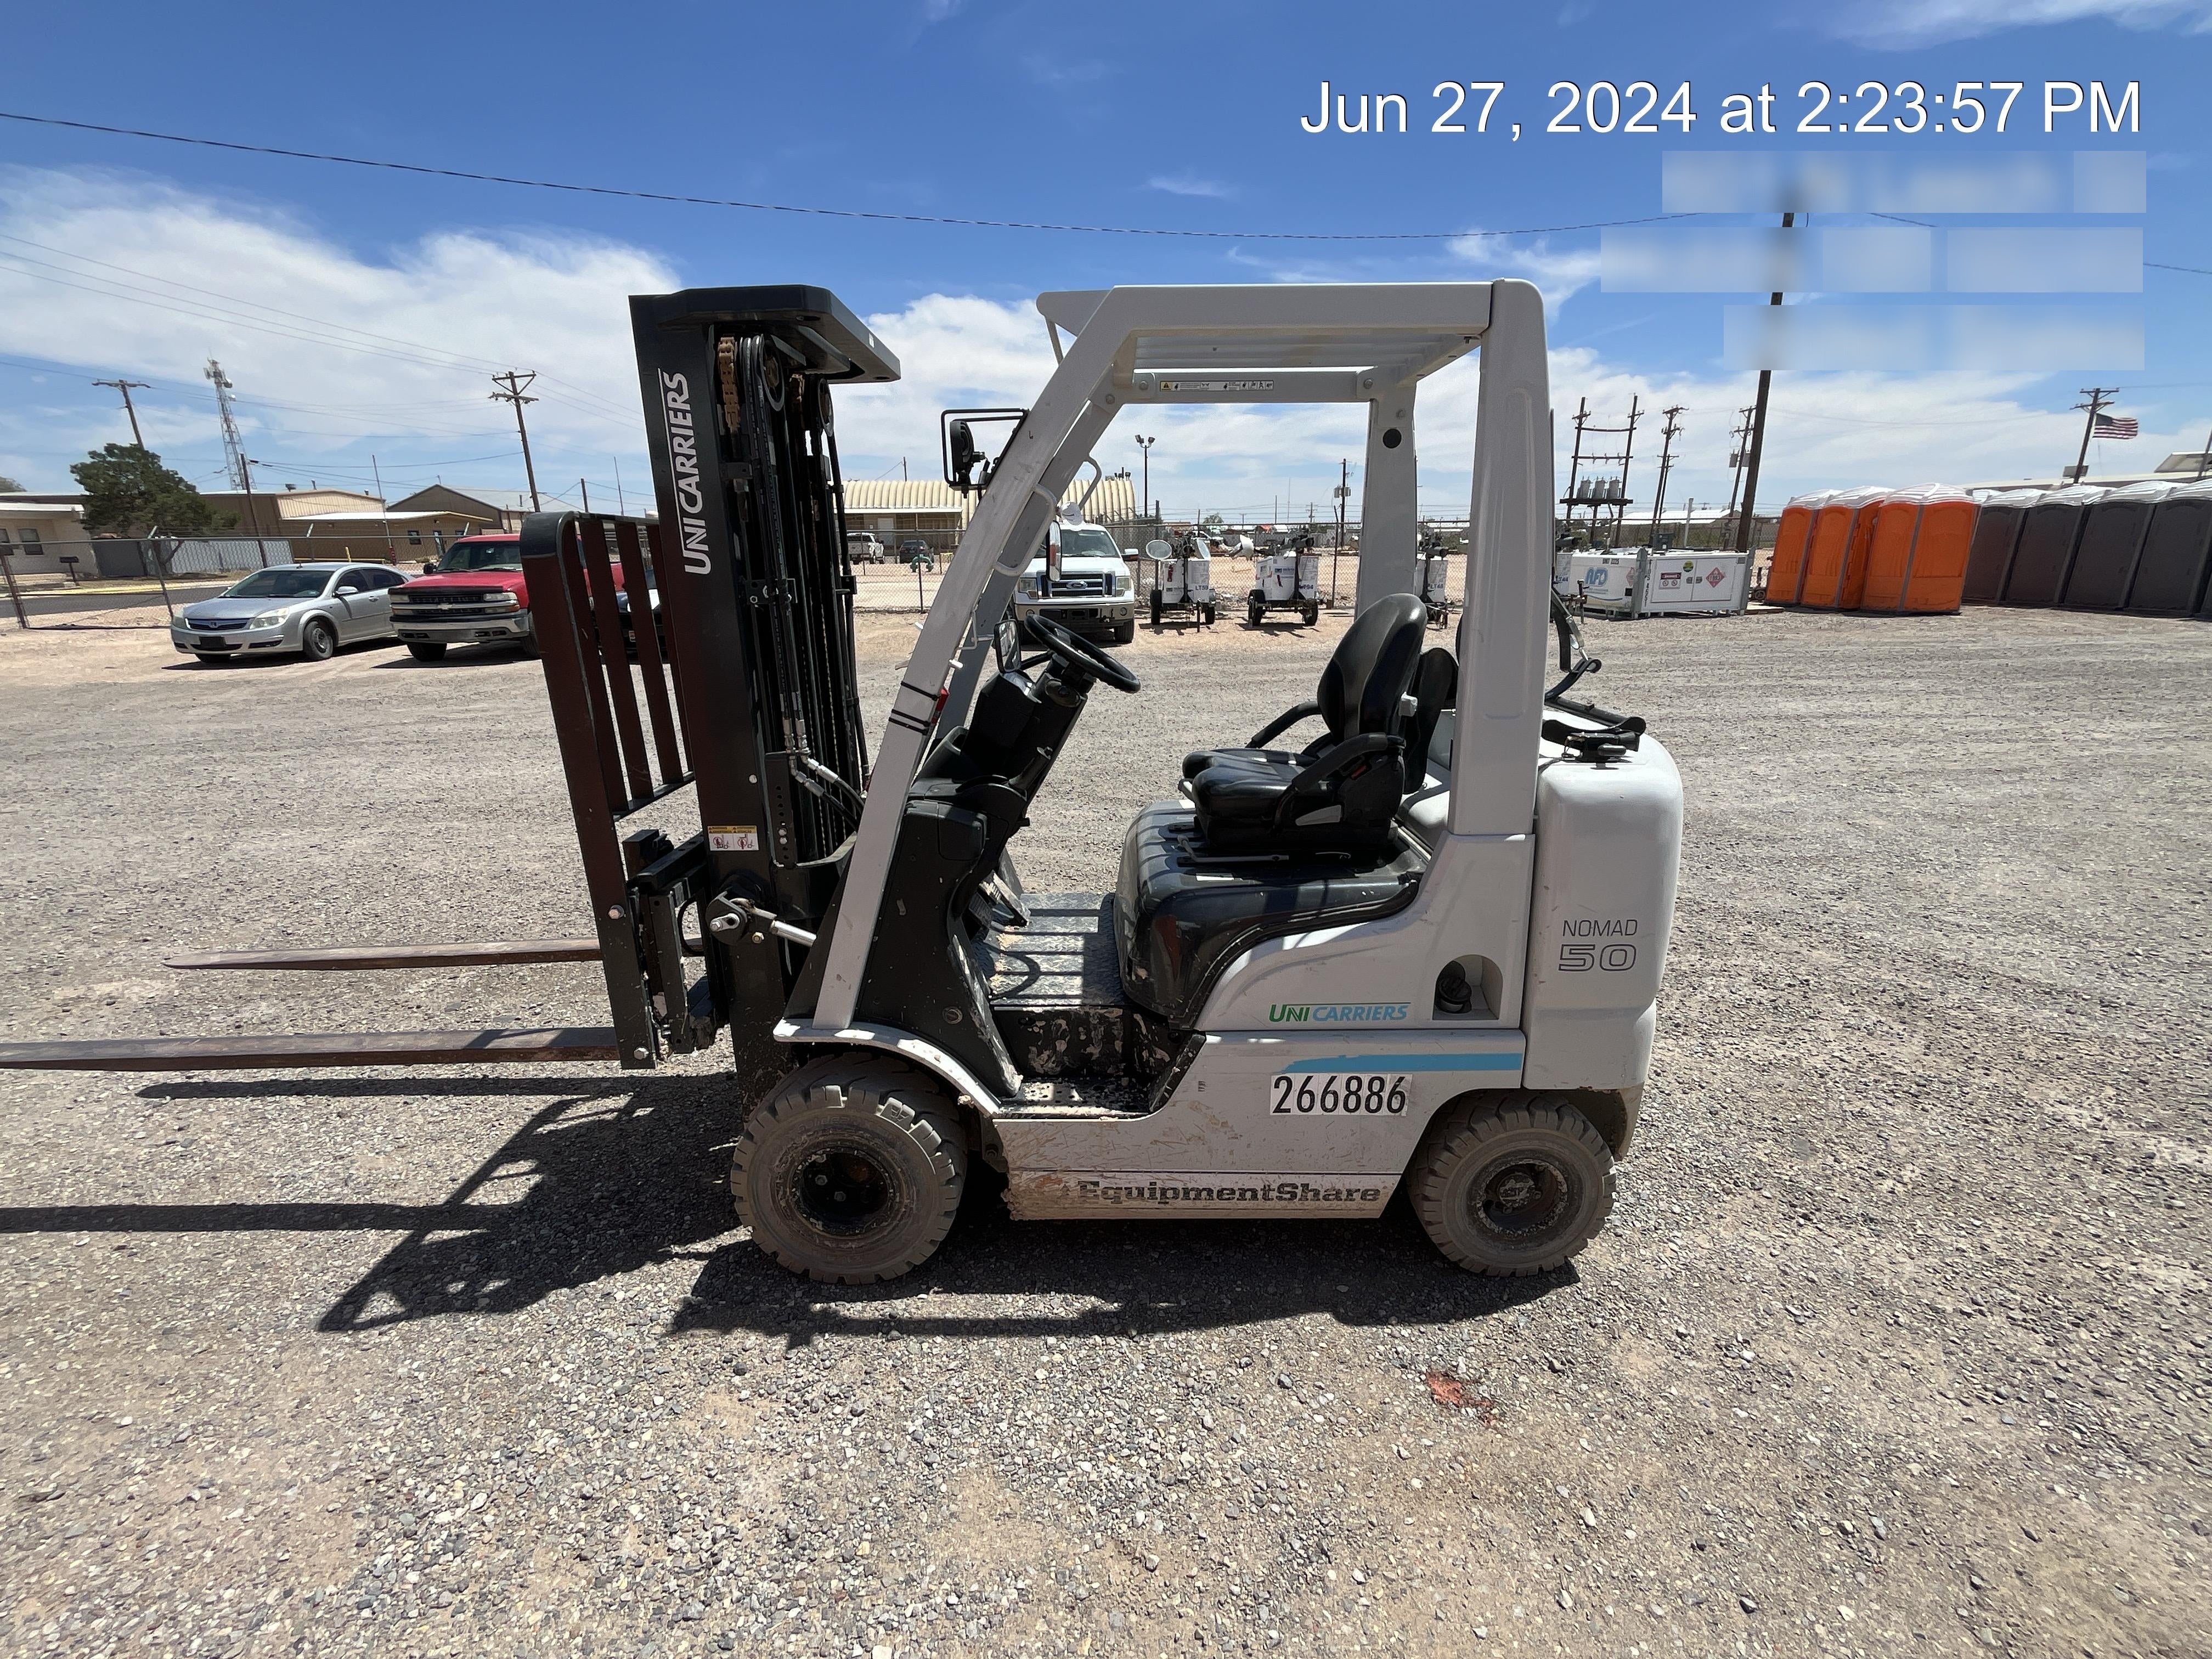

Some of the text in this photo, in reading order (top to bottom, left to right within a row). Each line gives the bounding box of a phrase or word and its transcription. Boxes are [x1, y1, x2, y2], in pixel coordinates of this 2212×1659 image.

[1562, 919, 1638, 937] NOMAD
[1558, 944, 1637, 972] 50
[1272, 1075, 1406, 1114] 266886
[1077, 1181, 1381, 1205] EquipmentShare
